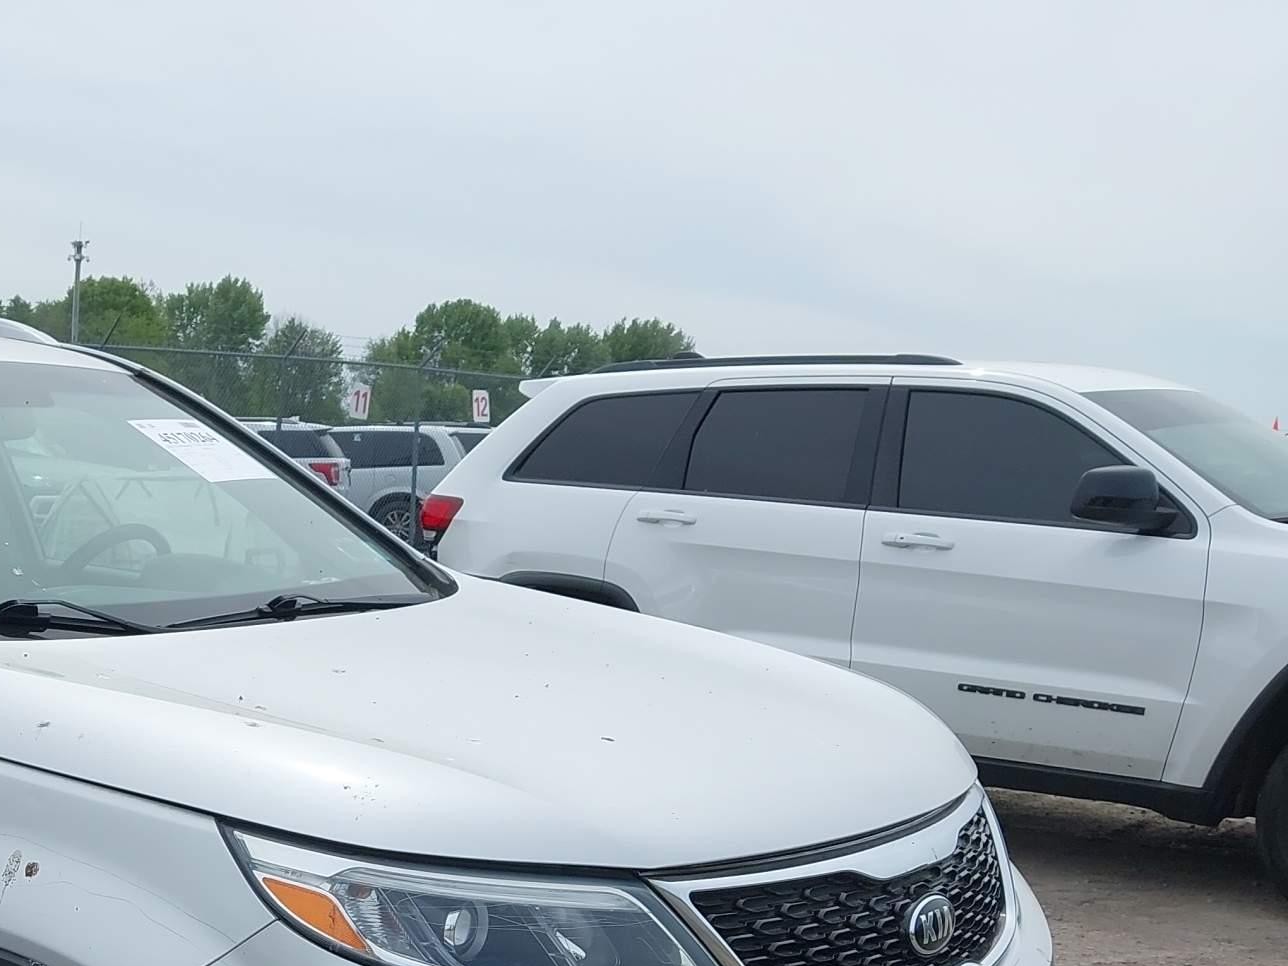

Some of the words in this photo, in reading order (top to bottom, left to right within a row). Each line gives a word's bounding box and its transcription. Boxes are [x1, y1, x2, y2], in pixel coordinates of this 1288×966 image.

[353, 390, 368, 413] 11
[474, 396, 487, 417] 12
[958, 684, 1025, 699] GRAND
[1033, 694, 1145, 715] CHEROKEE
[919, 905, 953, 945] KIA
